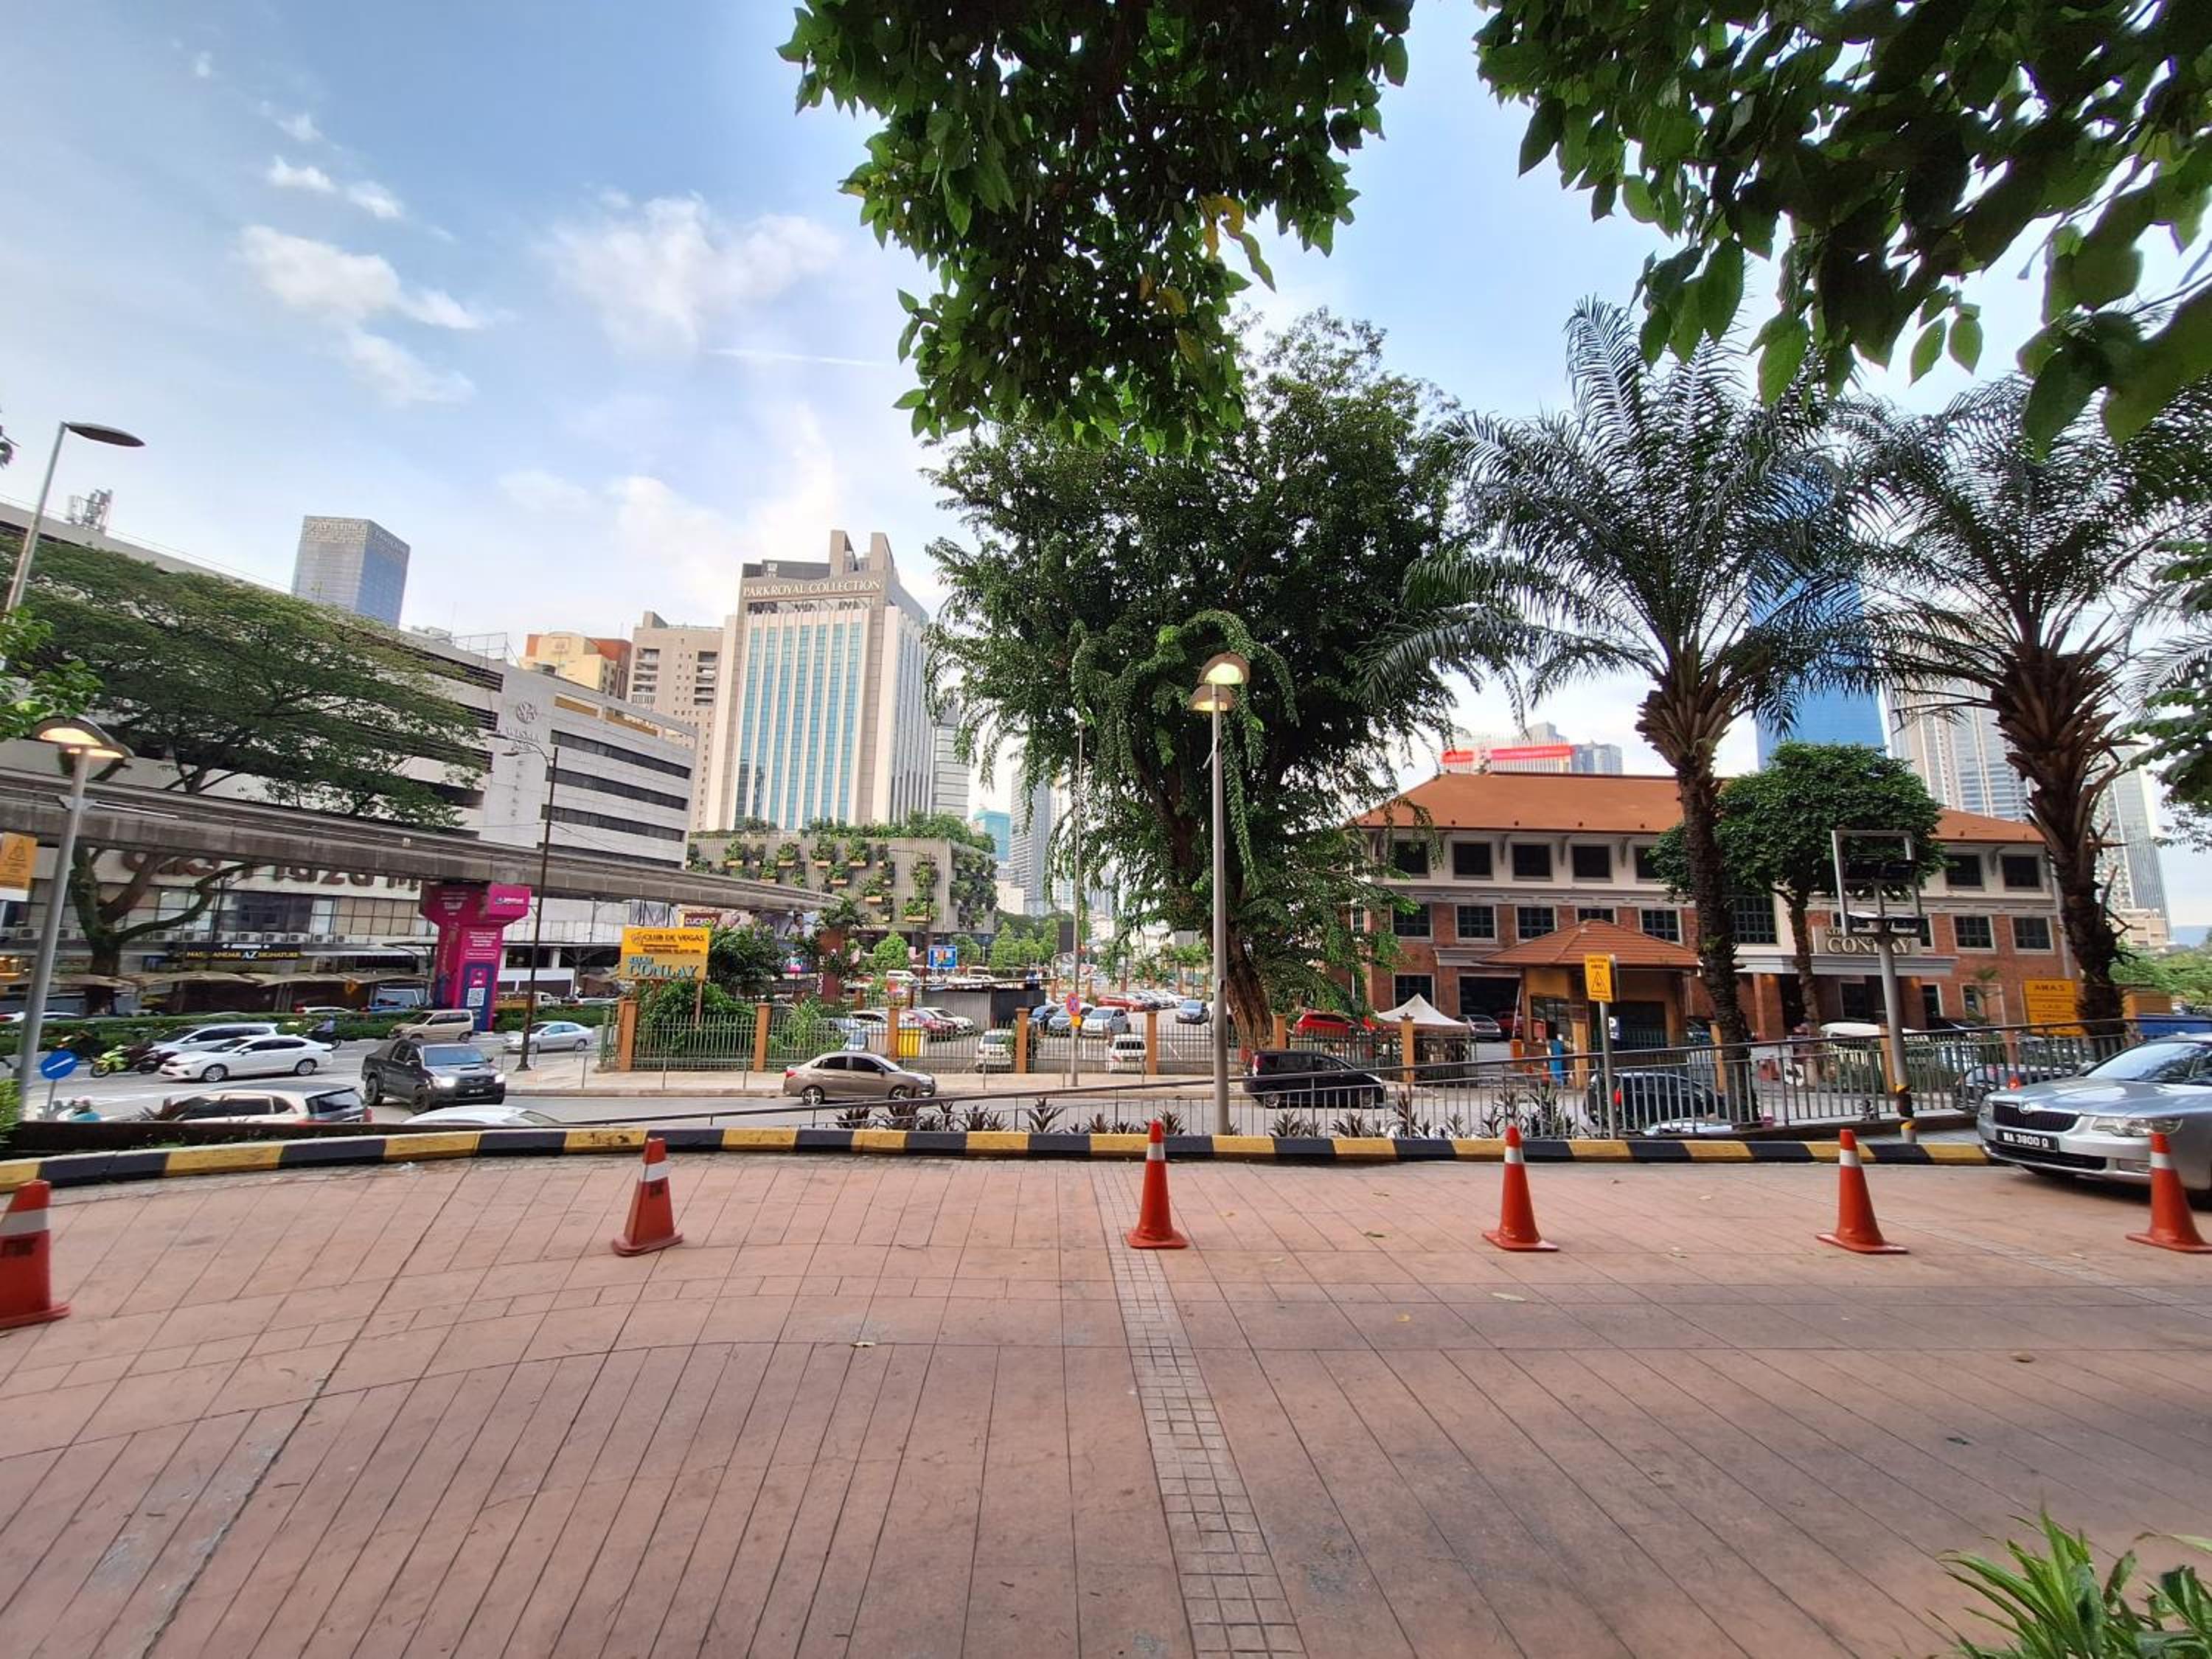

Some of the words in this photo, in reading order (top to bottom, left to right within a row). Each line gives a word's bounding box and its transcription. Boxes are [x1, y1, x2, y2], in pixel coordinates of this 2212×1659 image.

[743, 583, 806, 597] PARKROYAL
[810, 579, 882, 594] COLLECTION
[630, 964, 698, 978] CONLAY
